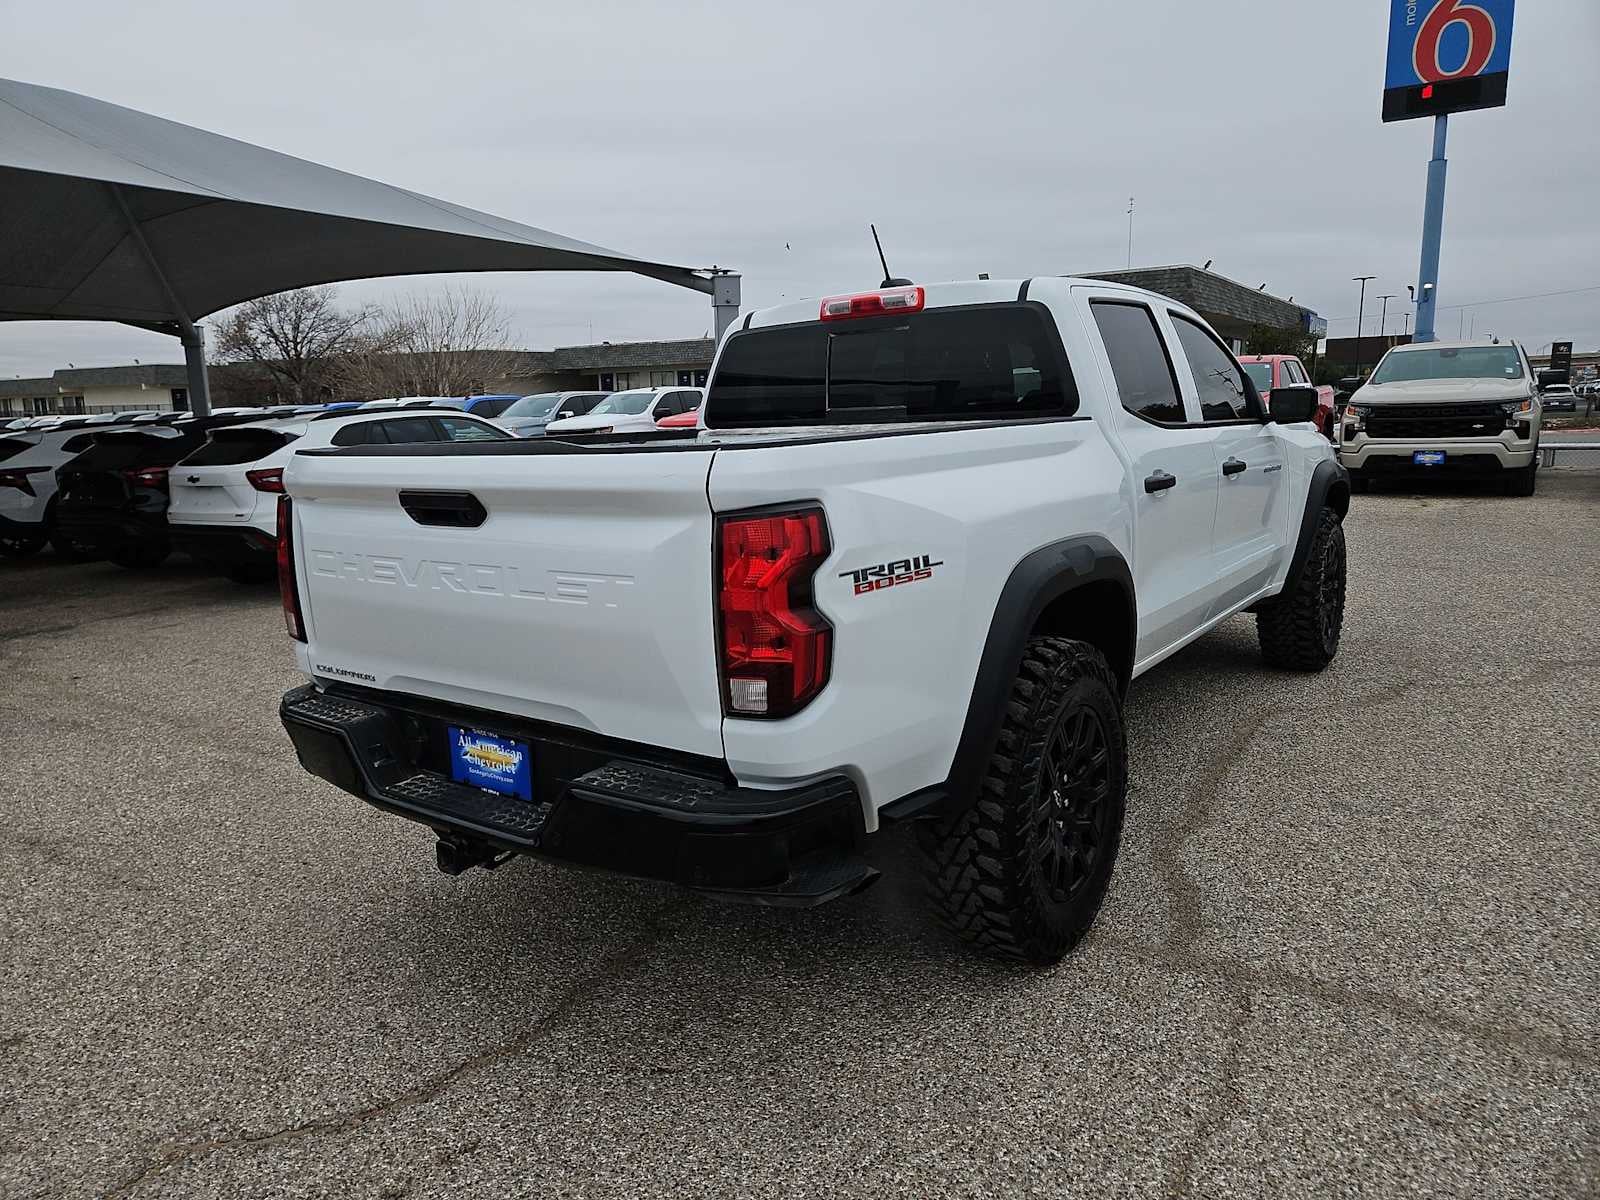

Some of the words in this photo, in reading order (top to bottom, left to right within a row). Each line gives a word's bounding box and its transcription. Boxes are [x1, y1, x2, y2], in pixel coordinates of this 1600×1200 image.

[1412, 0, 1497, 84] 6
[311, 549, 635, 608] CHEVROLET
[838, 554, 944, 583] TRAIL
[853, 567, 933, 597] BOSS
[458, 735, 472, 747] All
[472, 740, 522, 760] American
[467, 752, 515, 774] Chevrolet
